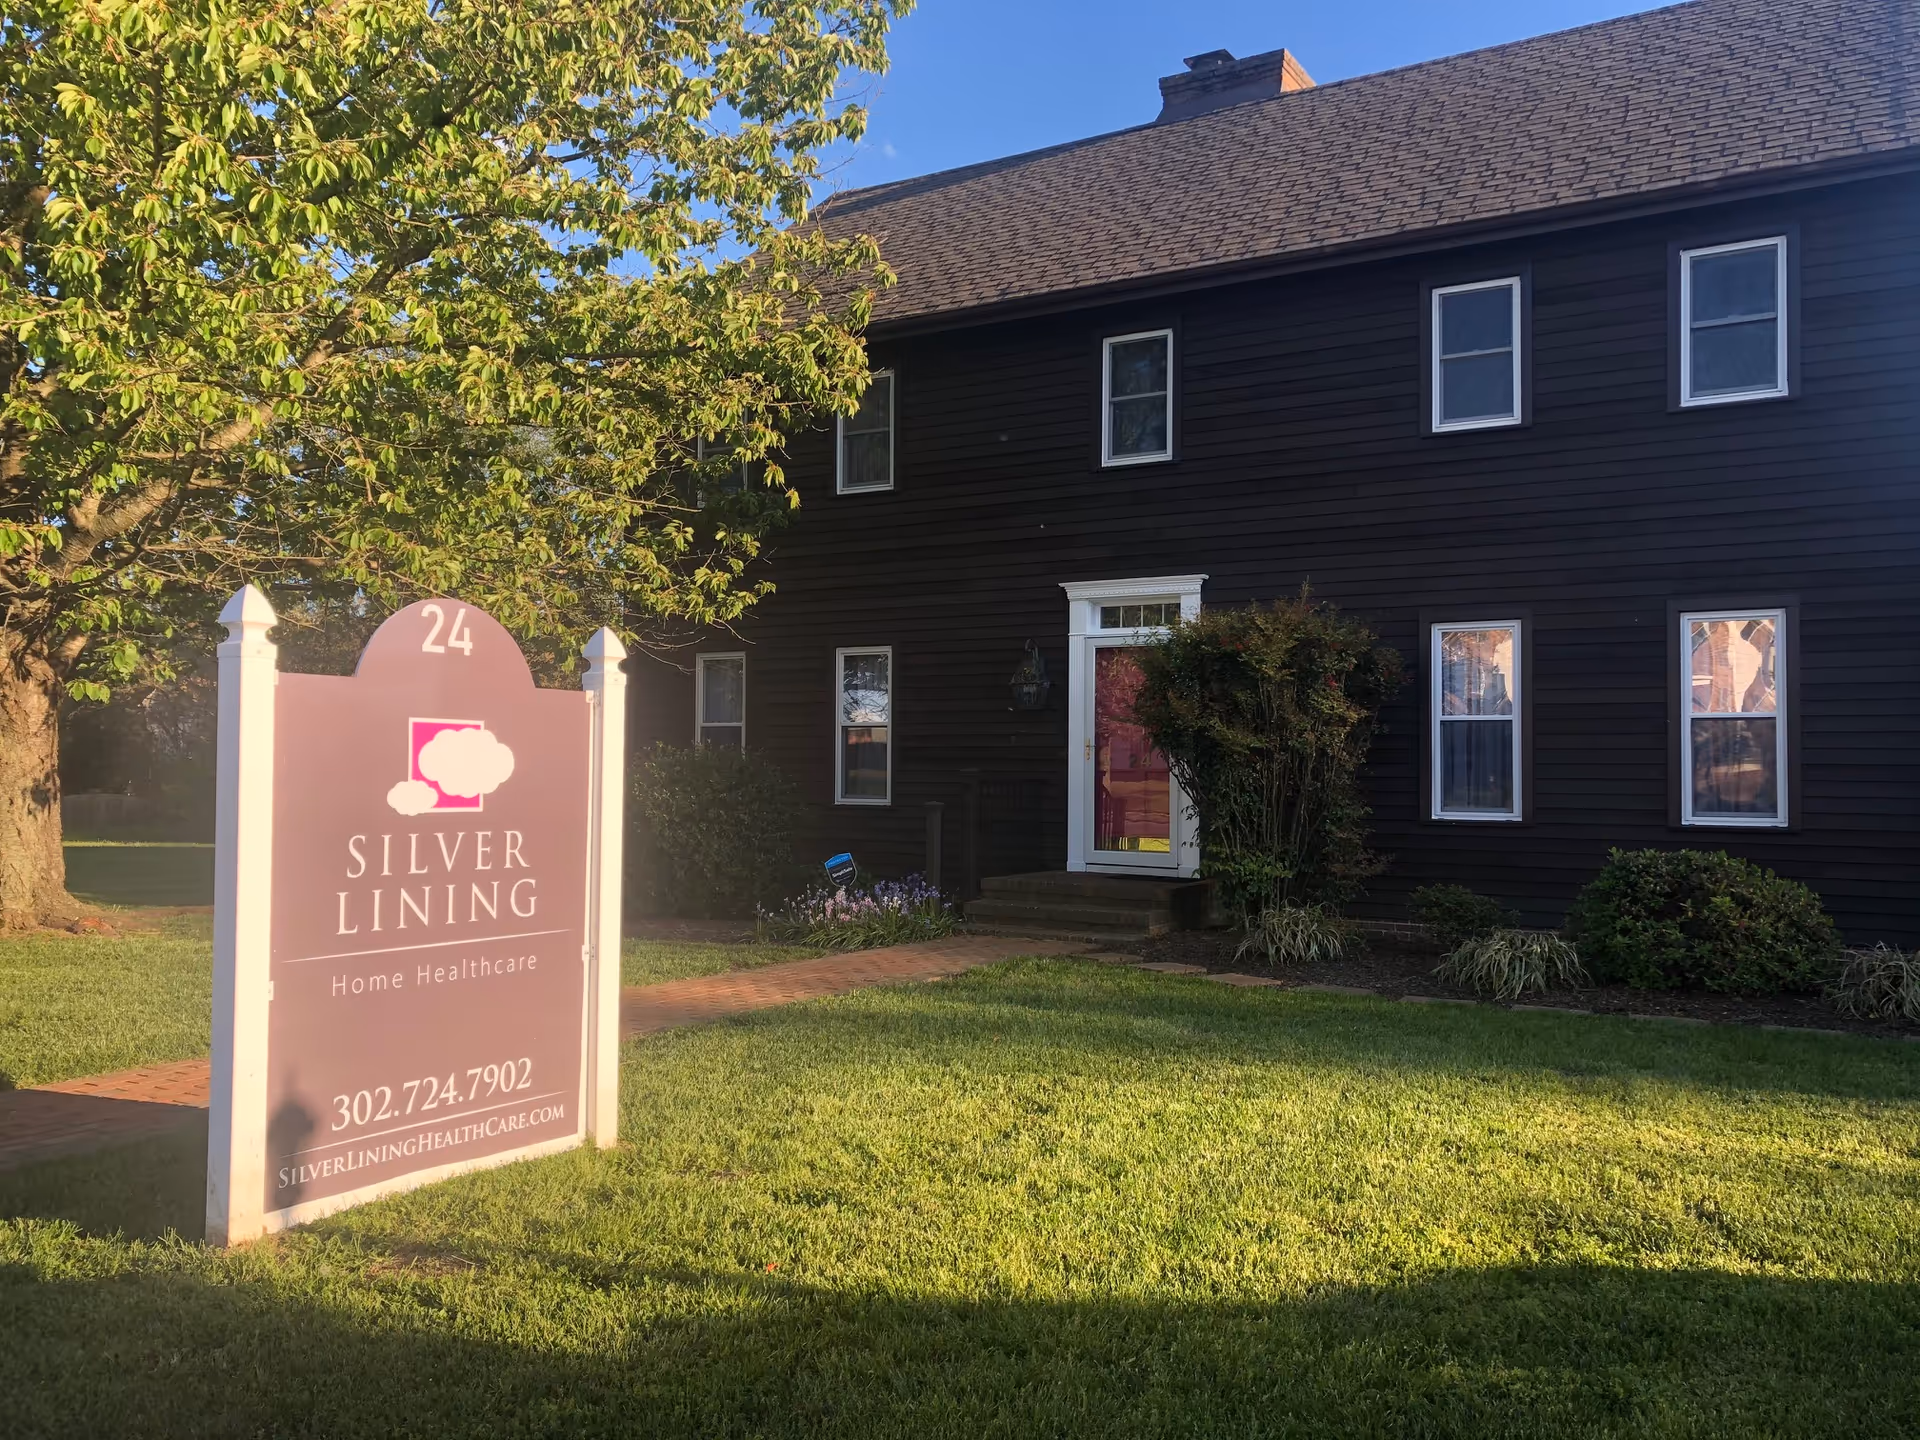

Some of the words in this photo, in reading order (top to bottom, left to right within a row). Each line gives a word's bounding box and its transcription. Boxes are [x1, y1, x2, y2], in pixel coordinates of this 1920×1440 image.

[421, 604, 473, 656] 24
[346, 830, 531, 878] SILVER
[335, 879, 538, 935] LINING
[332, 973, 403, 997] Home
[417, 954, 538, 986] Healthcare
[331, 1057, 533, 1131] 302.724.7902
